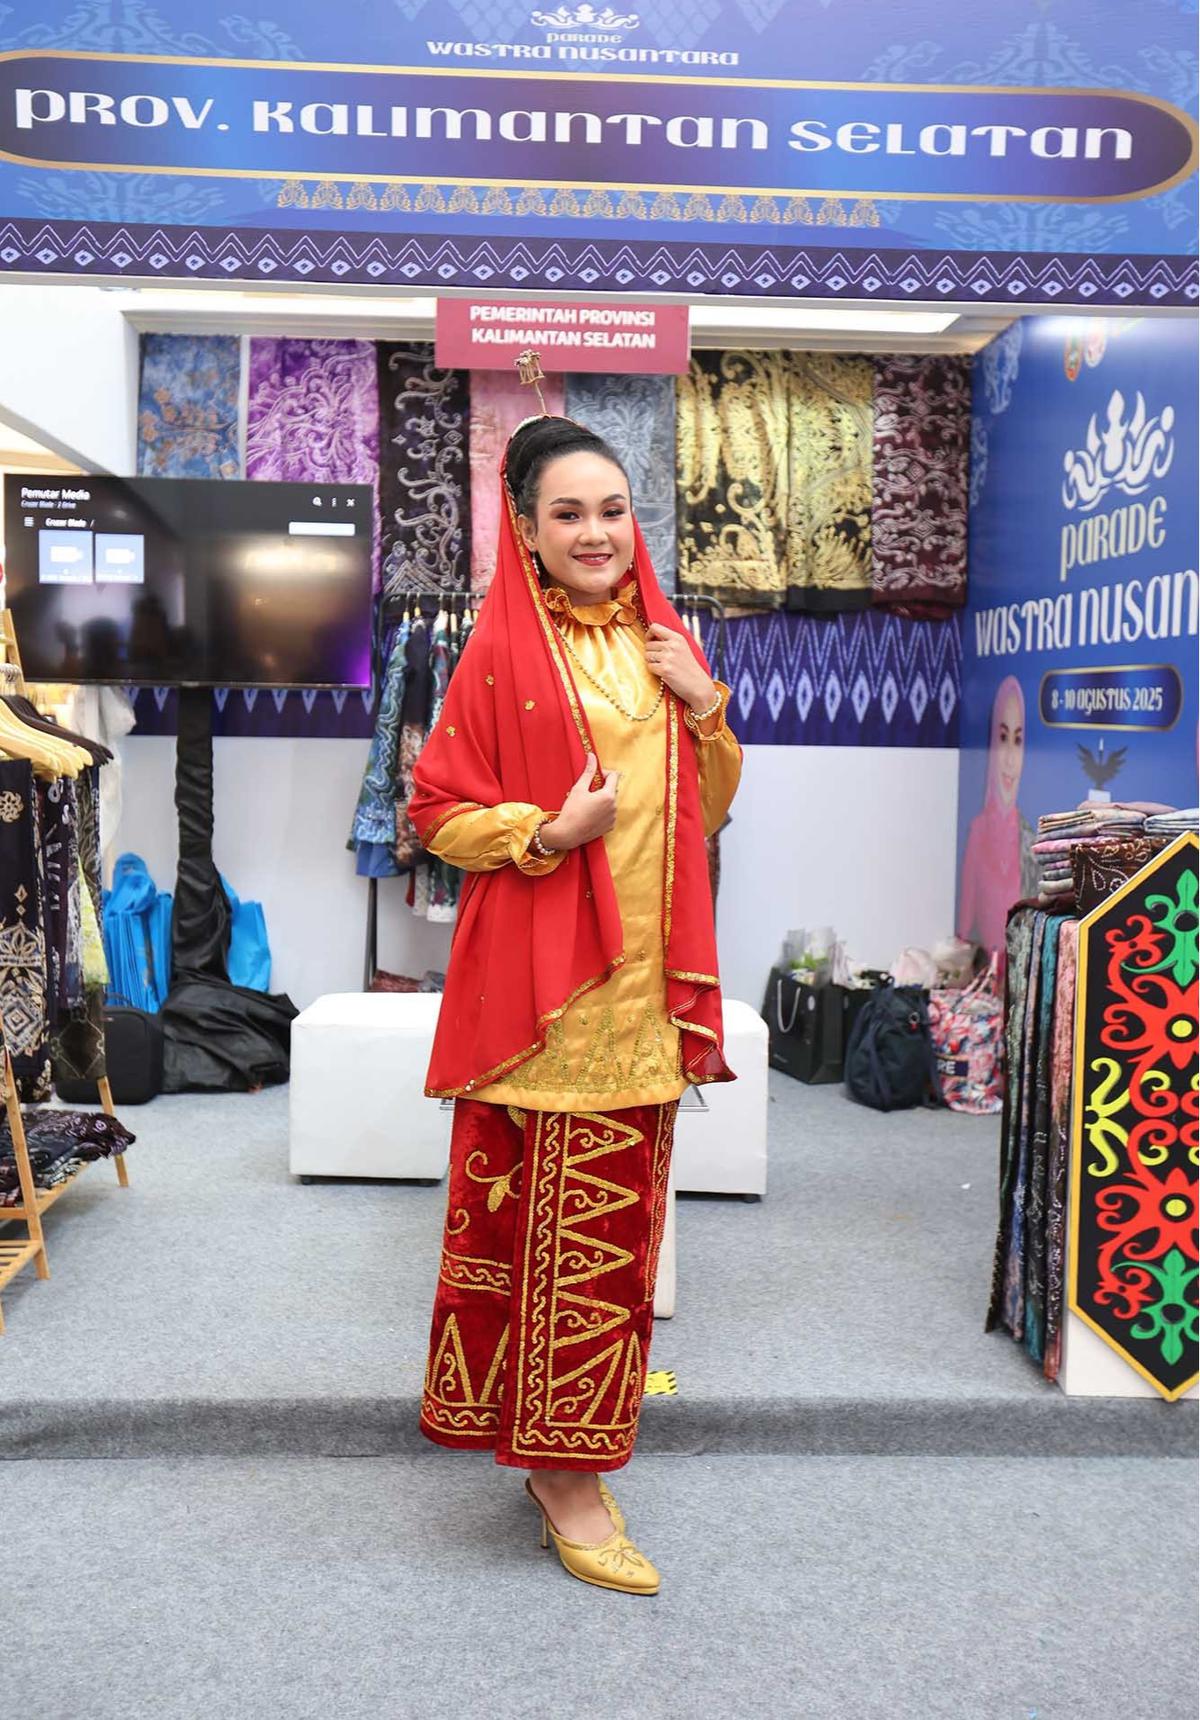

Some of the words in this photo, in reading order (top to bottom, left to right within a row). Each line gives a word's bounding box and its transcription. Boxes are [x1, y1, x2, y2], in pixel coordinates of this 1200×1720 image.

[546, 32, 623, 43] PARADE
[426, 41, 551, 59] WASTRA
[558, 46, 740, 66] NUSANTARA
[15, 88, 229, 131] PROV.
[253, 101, 768, 149] KALIMANTAN
[788, 120, 1132, 159] SELATAN
[470, 306, 577, 325] PEMERINTAH
[580, 310, 655, 326] PROVINSI
[471, 328, 581, 346] KALIMANTAN
[583, 332, 656, 348] SELATAN
[1060, 496, 1168, 581] PARADE
[975, 592, 1073, 657] WASTRA
[1078, 569, 1198, 646] NUSAN
[1051, 689, 1059, 710] 8
[1064, 689, 1076, 710] 10
[1077, 688, 1131, 715] AGUSTUS
[1132, 687, 1163, 711] 2025
